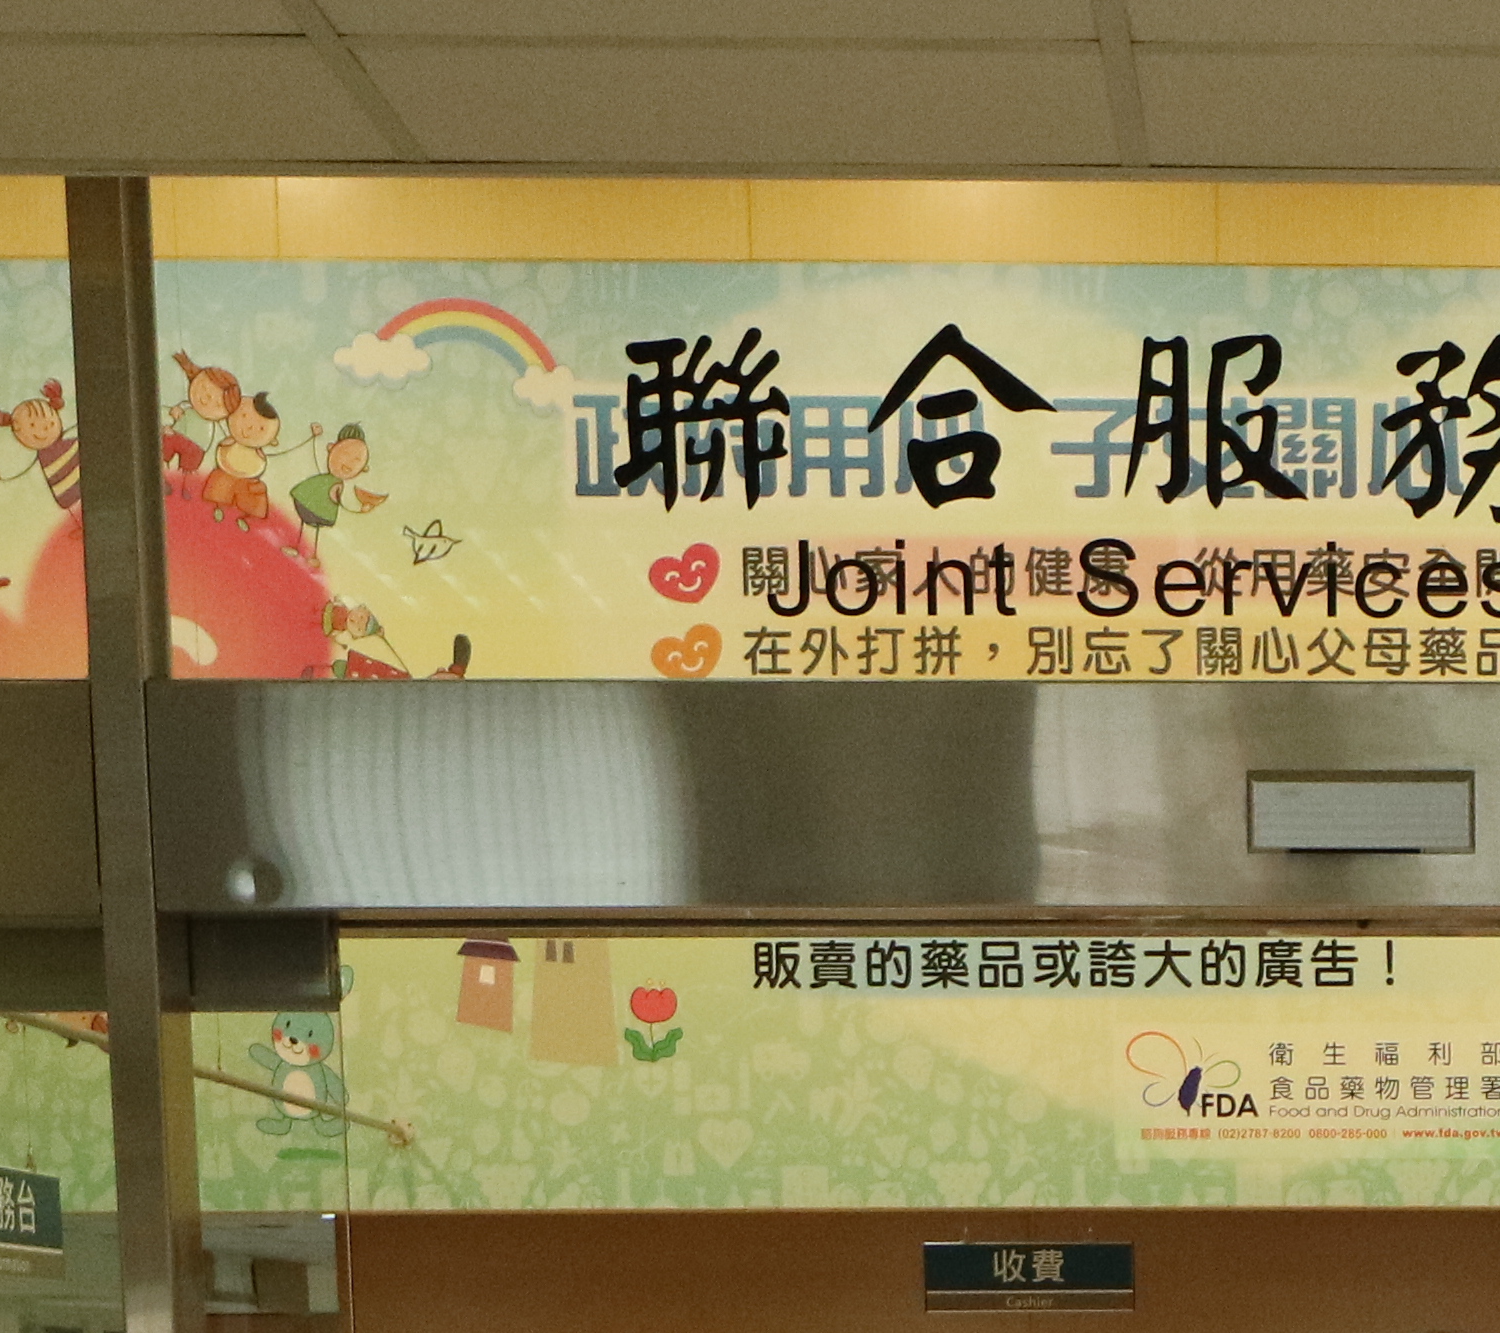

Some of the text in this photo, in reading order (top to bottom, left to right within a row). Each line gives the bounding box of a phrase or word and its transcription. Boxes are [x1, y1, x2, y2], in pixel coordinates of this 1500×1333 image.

[767, 539, 1017, 616] Joint
[753, 939, 1396, 989] 販賣的藥品或誇大的廣告！
[1201, 1093, 1259, 1118] FDA
[1269, 1105, 1310, 1117] Food
[1319, 1105, 1349, 1117] and
[1353, 1105, 1391, 1120] Drug
[992, 1248, 1065, 1283] 收費
